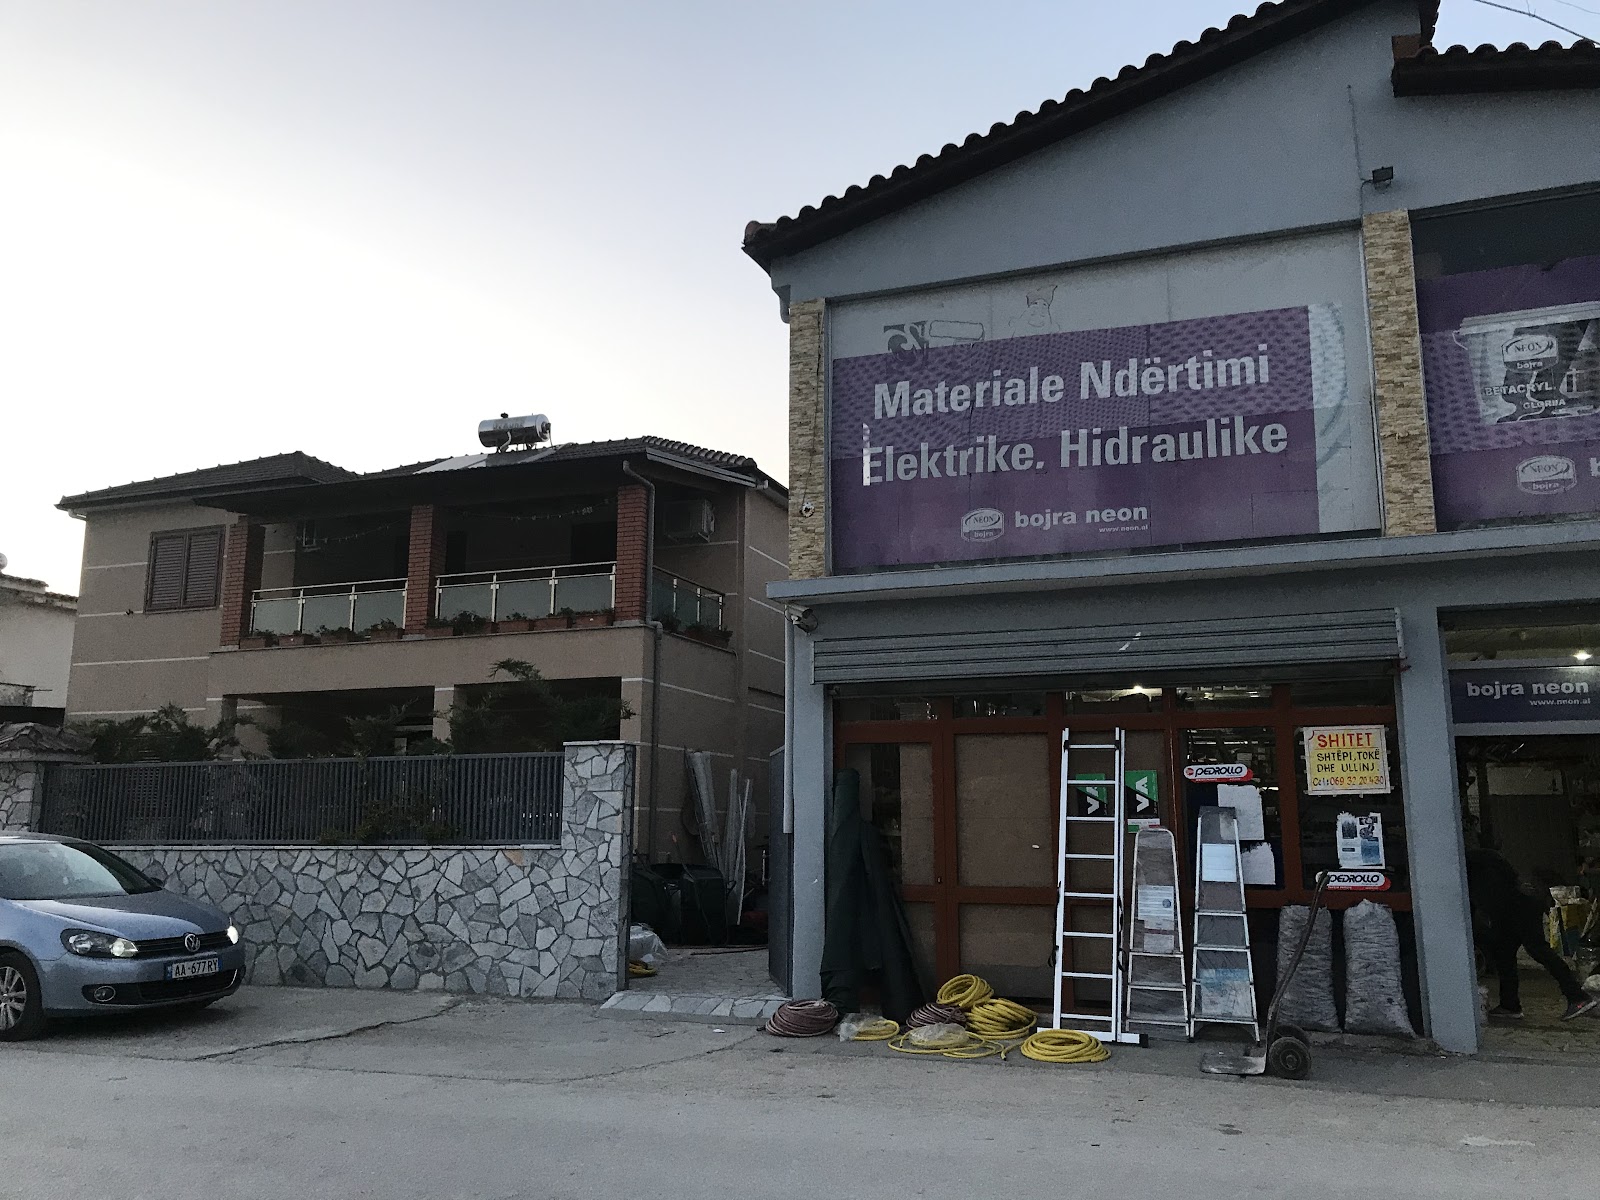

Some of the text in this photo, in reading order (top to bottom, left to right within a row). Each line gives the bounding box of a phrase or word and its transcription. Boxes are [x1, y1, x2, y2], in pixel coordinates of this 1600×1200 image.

[874, 343, 1269, 420] Materiale Ndërtimi
[862, 415, 1288, 486] Elektrike. Hidraulike
[1532, 482, 1560, 491] bojra
[972, 513, 996, 524] NEON
[1015, 506, 1148, 531] bojra neon
[1099, 524, 1149, 533] www.neon.al
[1466, 681, 1589, 700] bojra neon
[1529, 697, 1591, 706] www.neon.al
[1317, 732, 1373, 748] SHITET
[1195, 766, 1243, 777] PEDROLLO
[1316, 763, 1335, 773] DHE
